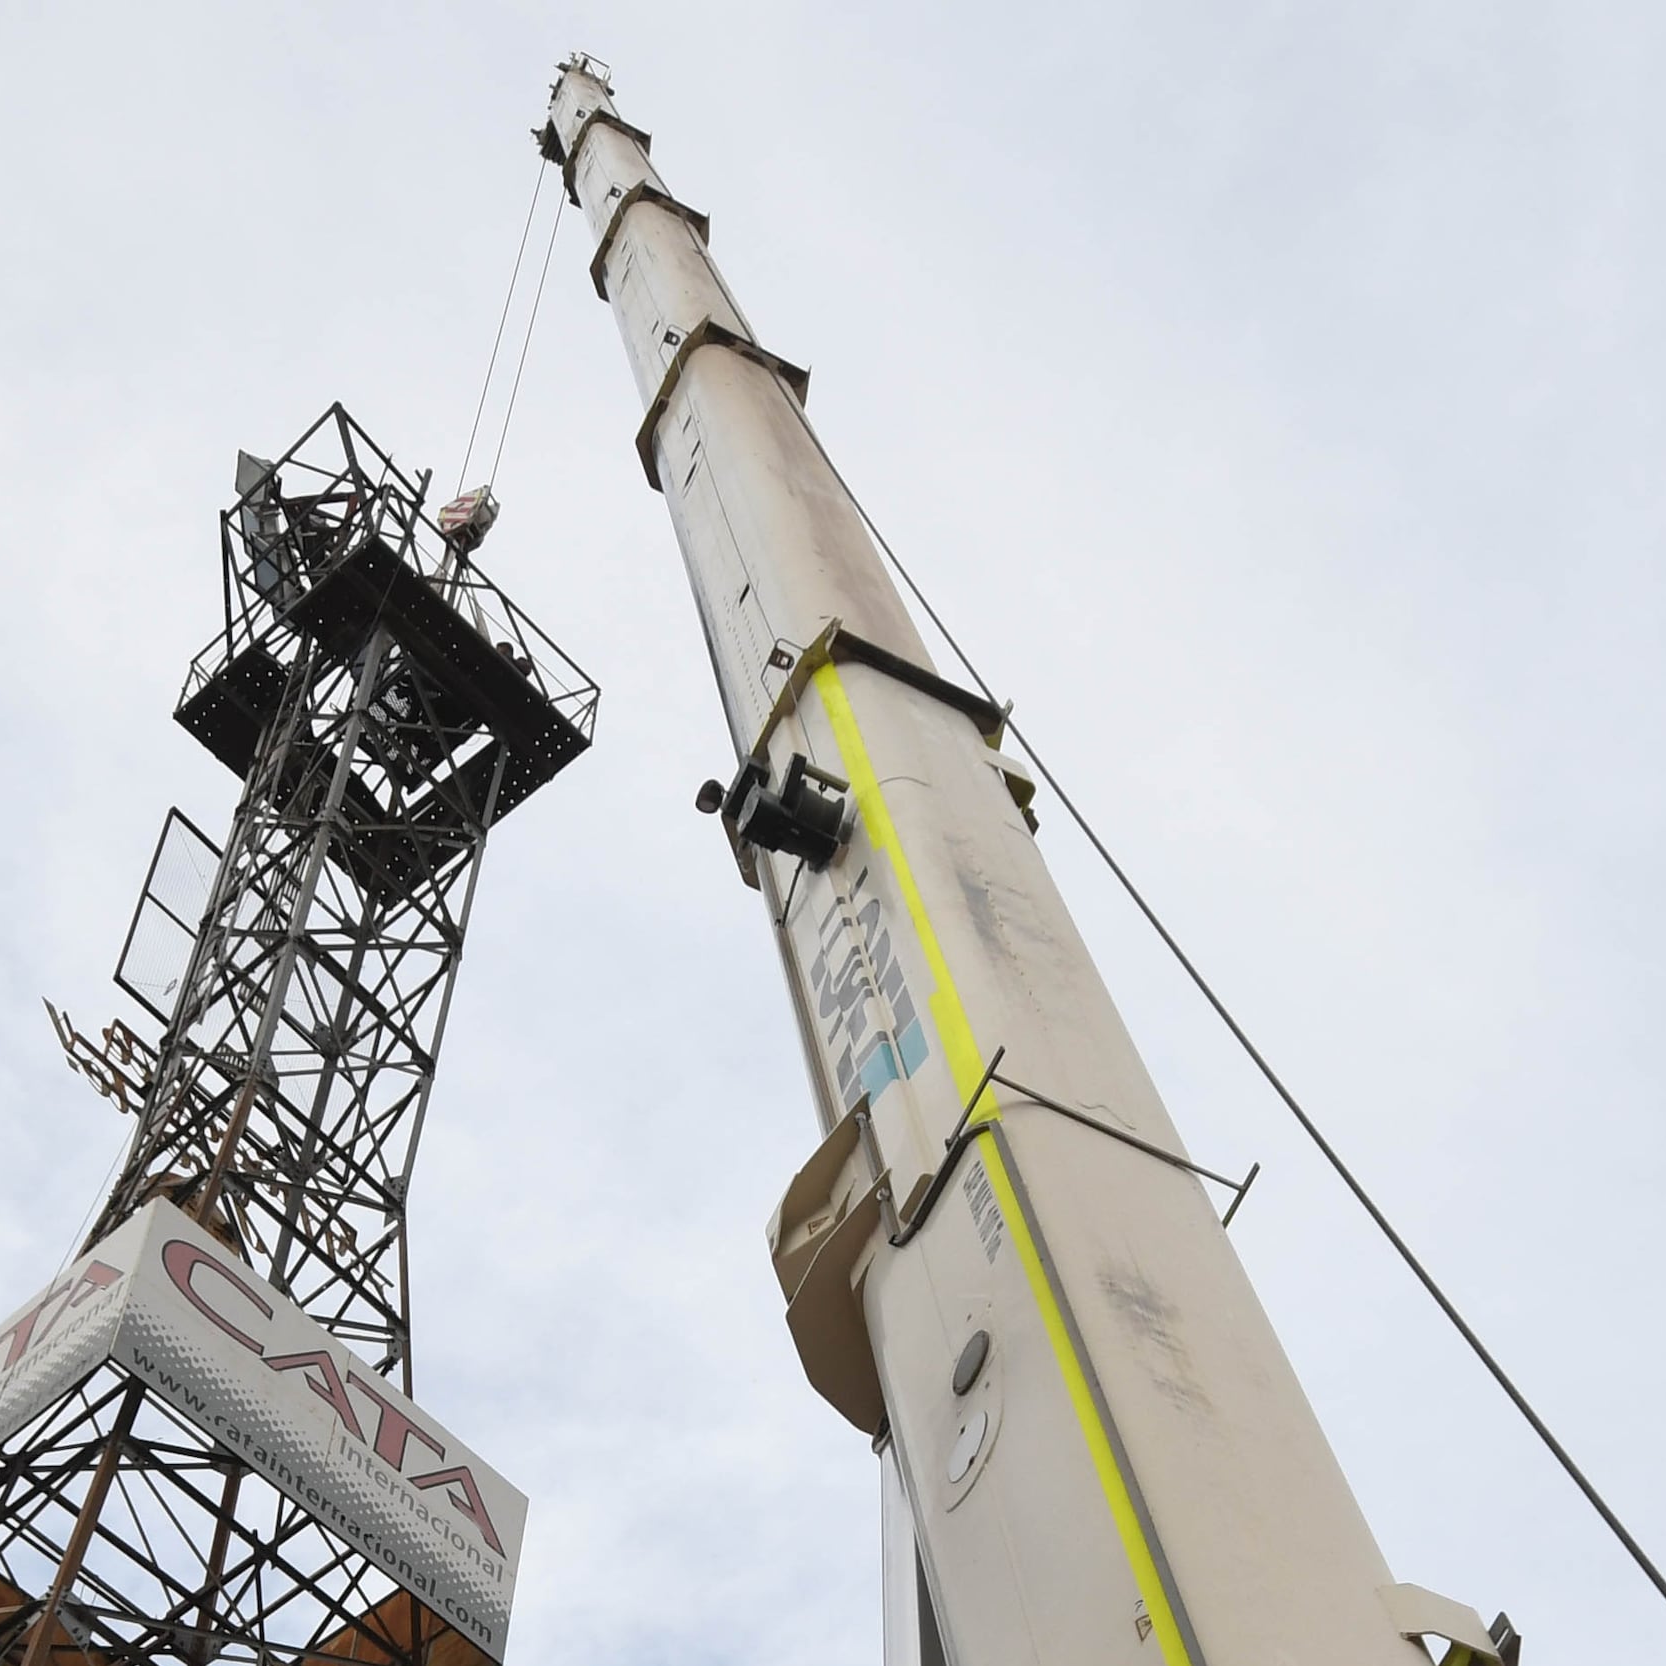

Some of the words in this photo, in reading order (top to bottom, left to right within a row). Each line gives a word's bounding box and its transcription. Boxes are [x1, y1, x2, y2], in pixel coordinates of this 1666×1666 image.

[133, 1348, 493, 1645] www.catainternacional.com
[162, 1239, 507, 1560] CATA
[339, 1436, 504, 1582] Internacional
